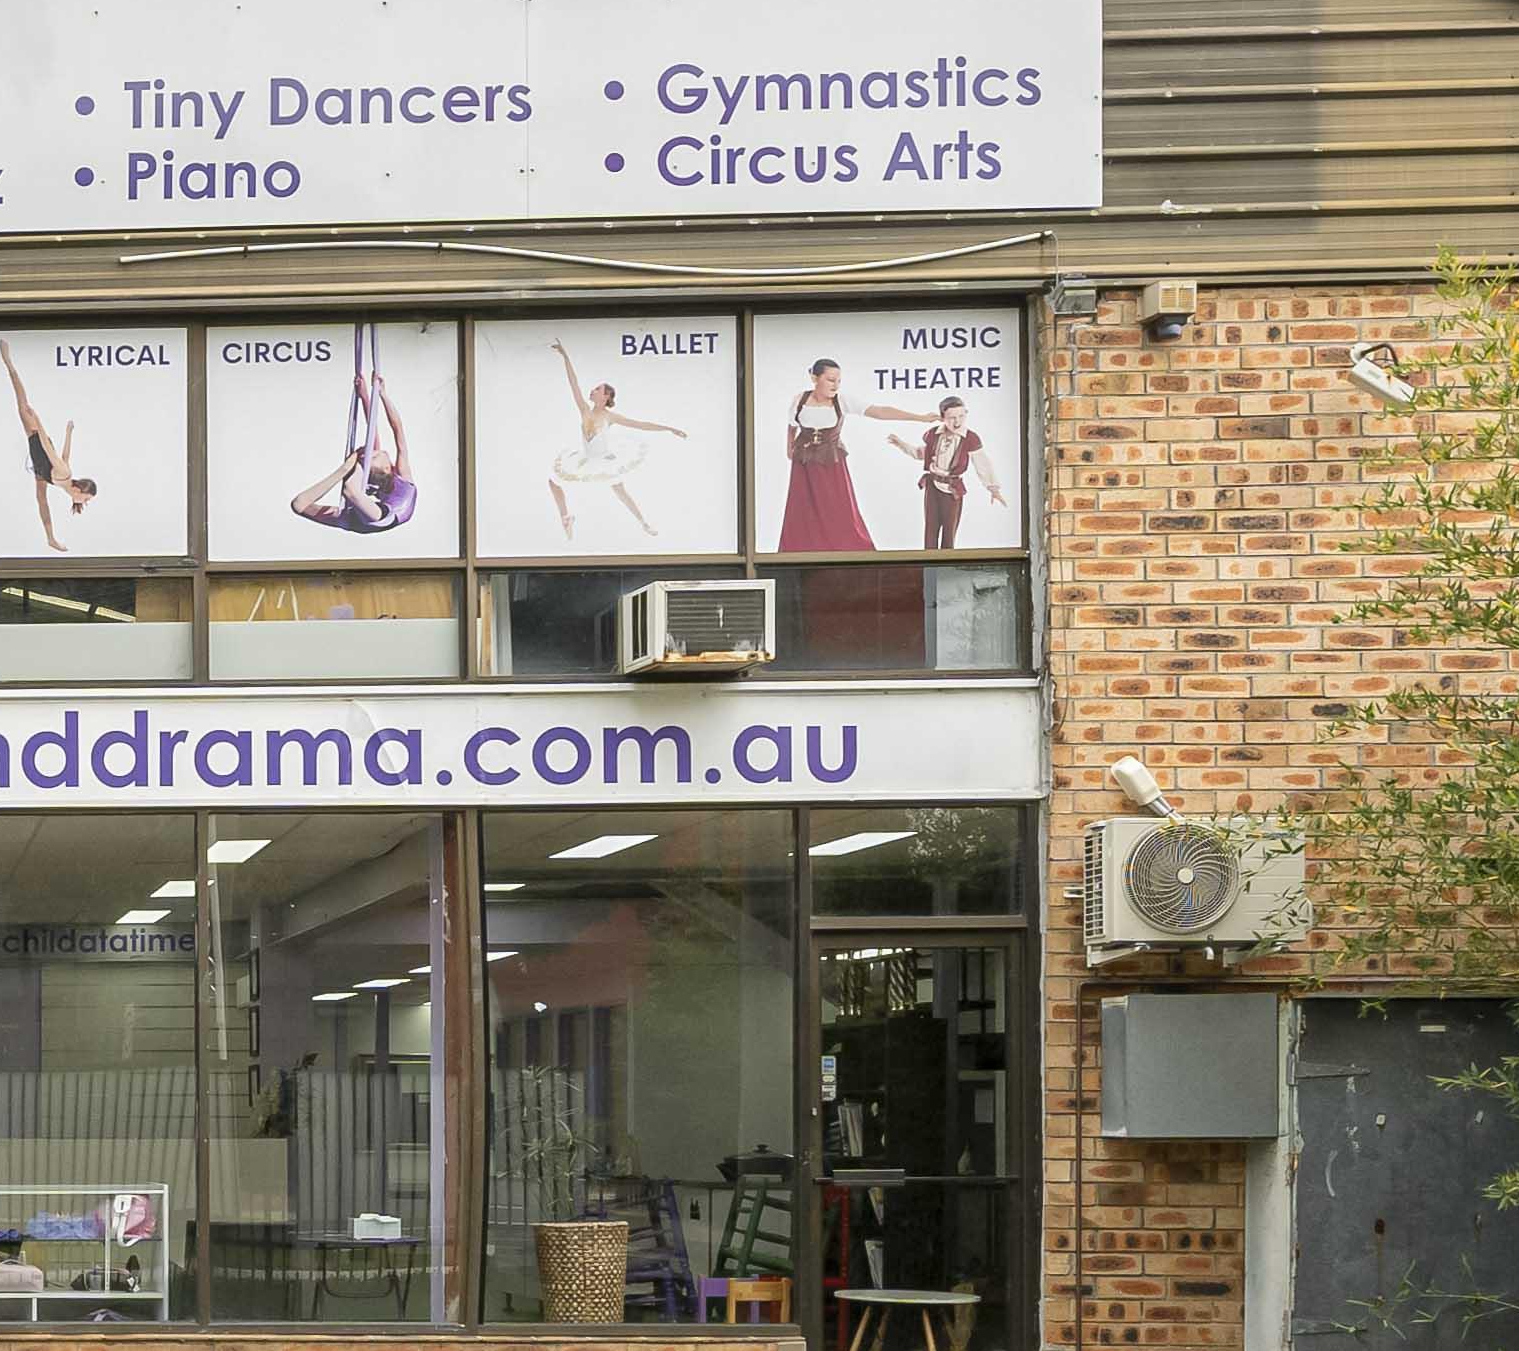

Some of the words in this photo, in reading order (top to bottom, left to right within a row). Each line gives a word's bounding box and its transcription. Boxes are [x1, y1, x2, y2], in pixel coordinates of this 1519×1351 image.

[658, 56, 1041, 114] Gymnastics
[124, 79, 245, 132] Tiny
[270, 78, 532, 125] Dancers
[658, 135, 858, 186] Circus
[882, 130, 1001, 181] Arts
[128, 150, 300, 200] Piano
[622, 333, 719, 355] BALLET
[903, 327, 1001, 349] MUSIC
[57, 345, 170, 366] LYRICAL
[222, 341, 331, 363] CIRCUS
[874, 367, 1000, 390] THEATRE
